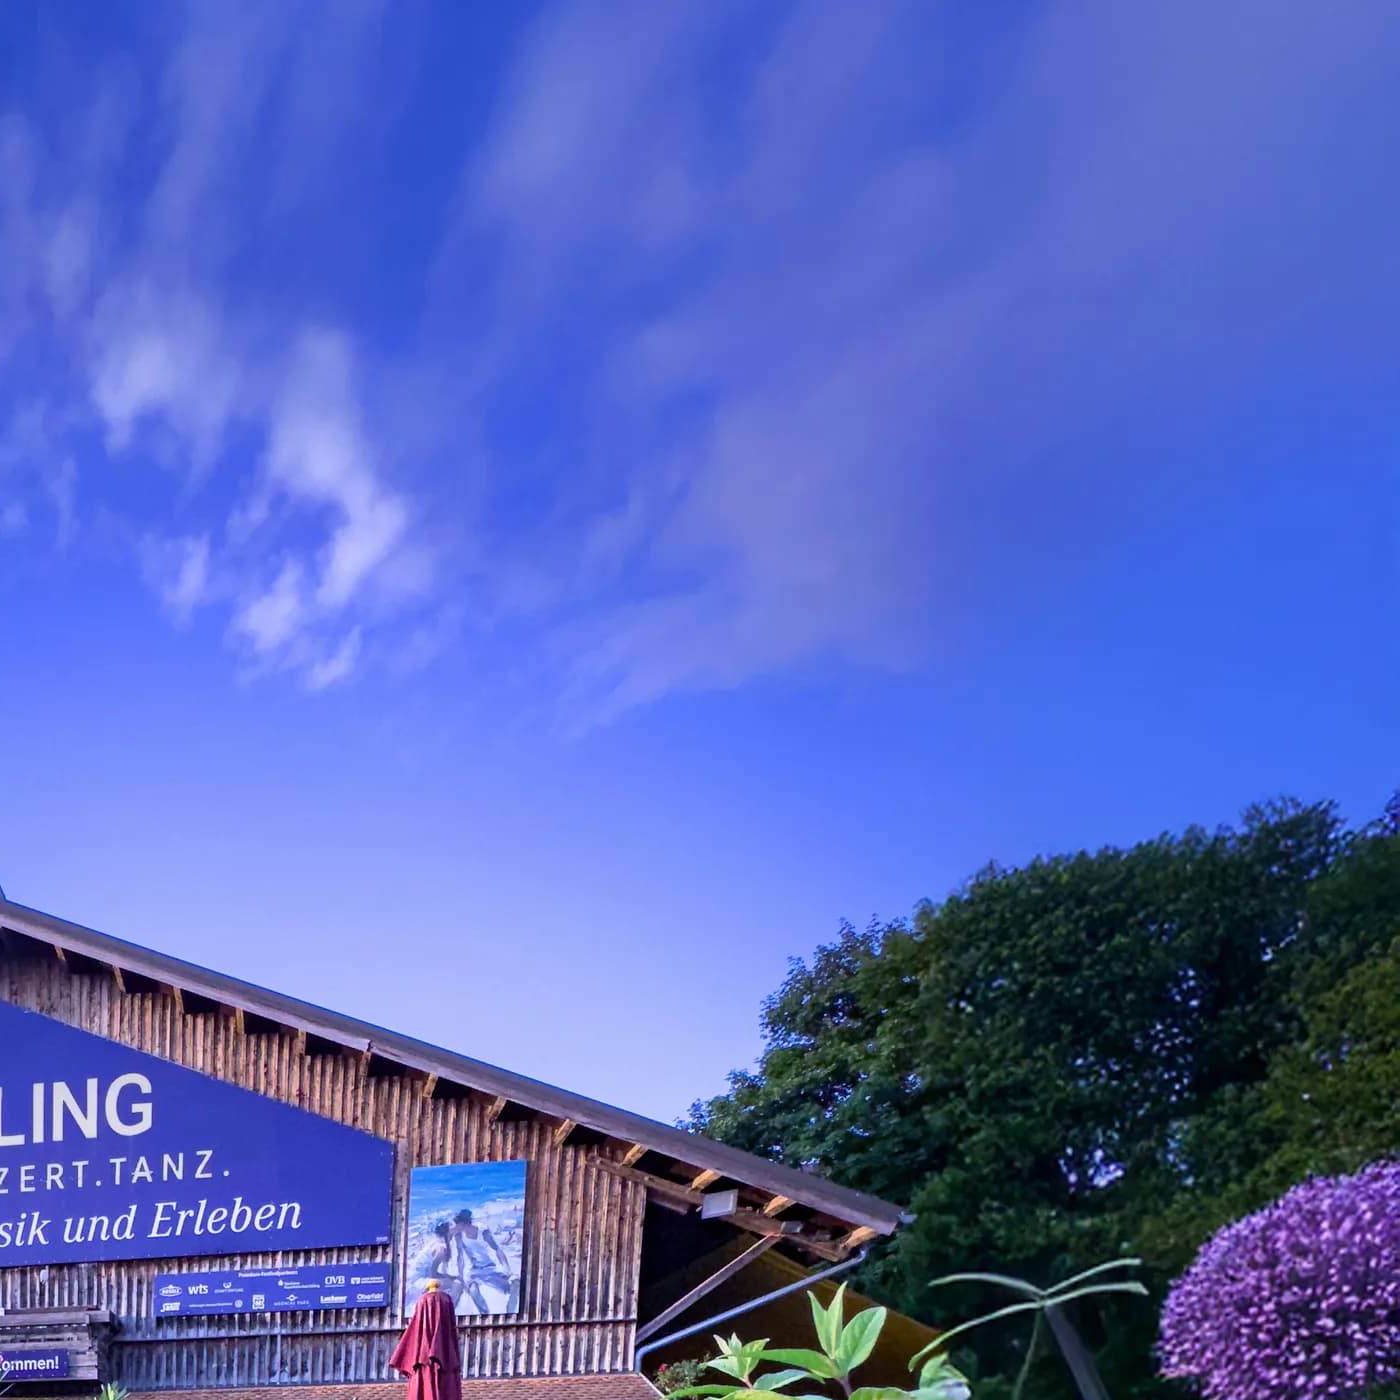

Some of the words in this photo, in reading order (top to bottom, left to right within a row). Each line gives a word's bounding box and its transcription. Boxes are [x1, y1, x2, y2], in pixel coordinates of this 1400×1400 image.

[63, 1205, 137, 1243] und
[147, 1197, 302, 1238] Erleben
[188, 1284, 209, 1295] wts
